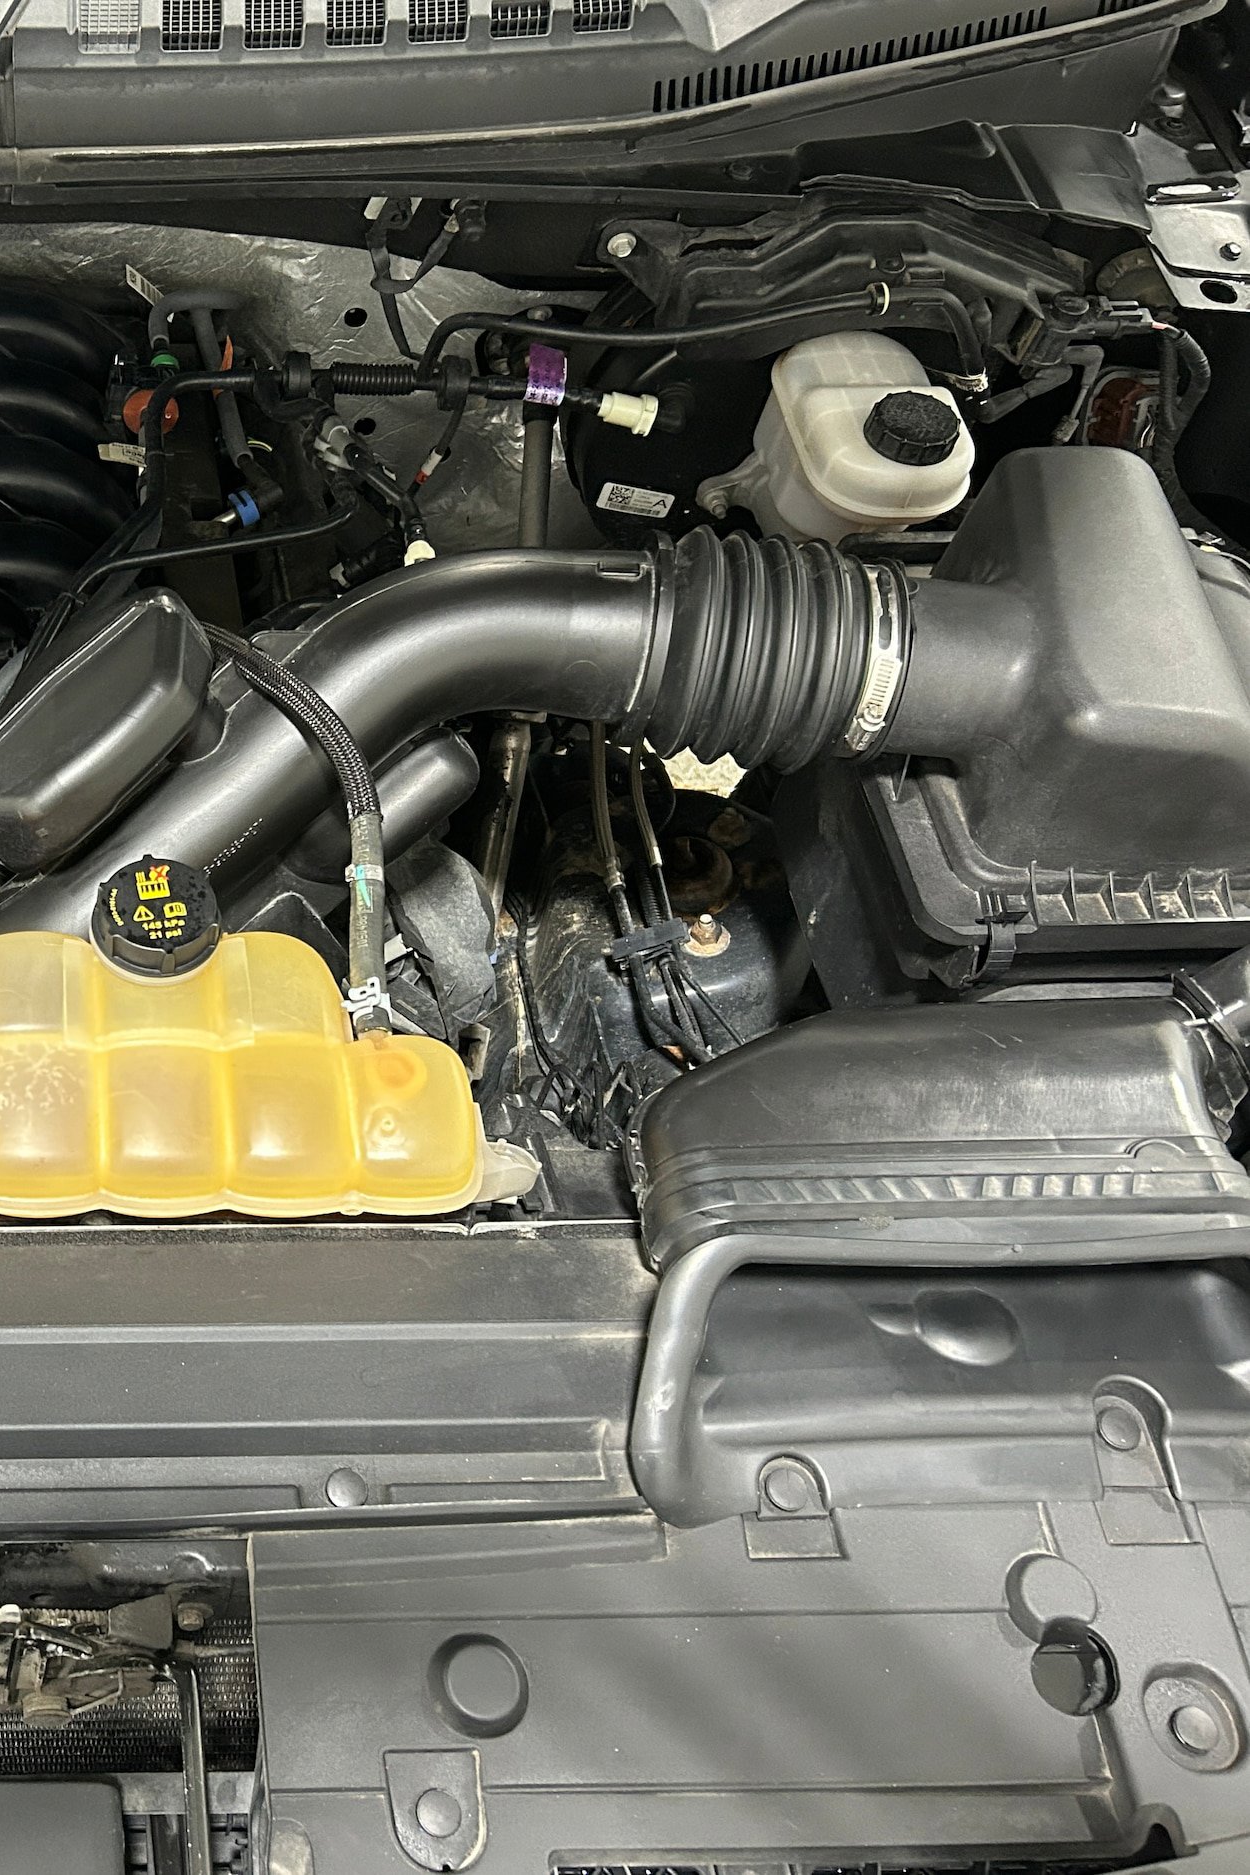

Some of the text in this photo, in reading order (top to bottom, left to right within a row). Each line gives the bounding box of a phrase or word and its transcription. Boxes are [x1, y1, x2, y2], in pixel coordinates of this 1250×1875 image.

[653, 499, 667, 509] A
[142, 919, 186, 931] 145 kPa
[149, 928, 183, 940] 21 psi
